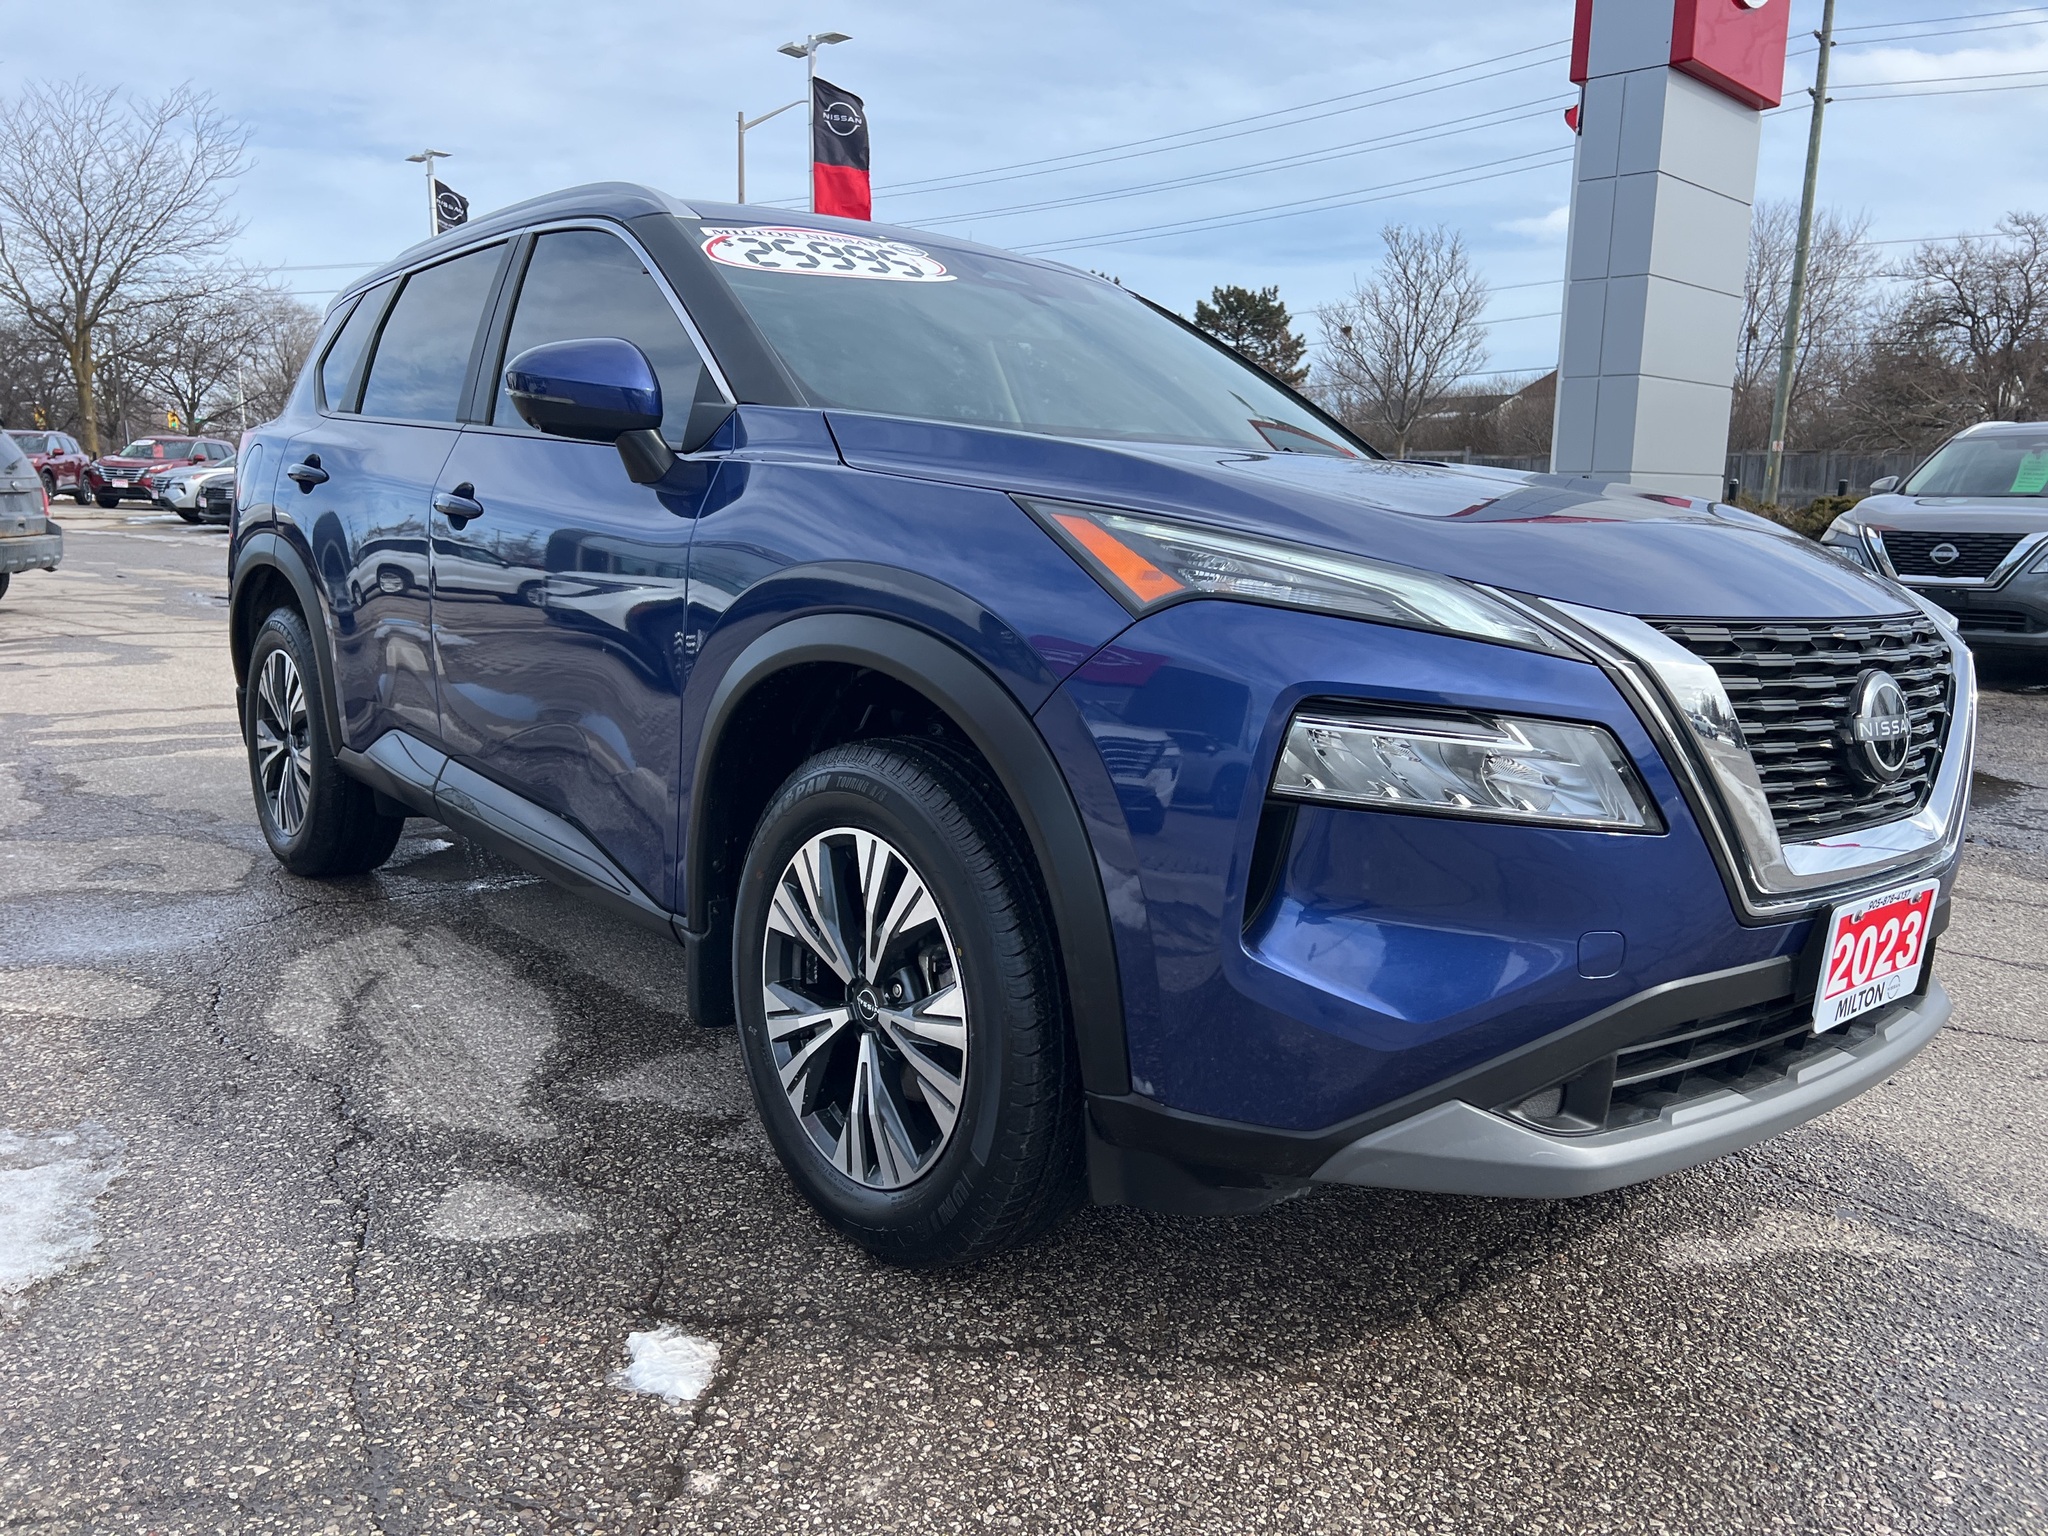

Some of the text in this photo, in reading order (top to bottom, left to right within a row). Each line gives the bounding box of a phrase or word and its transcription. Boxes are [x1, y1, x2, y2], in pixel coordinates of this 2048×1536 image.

[823, 112, 862, 125] NISSAN
[711, 228, 882, 248] MILTON NISSAN
[1826, 911, 1923, 996] 2023
[1834, 982, 1886, 1022] MILTON
